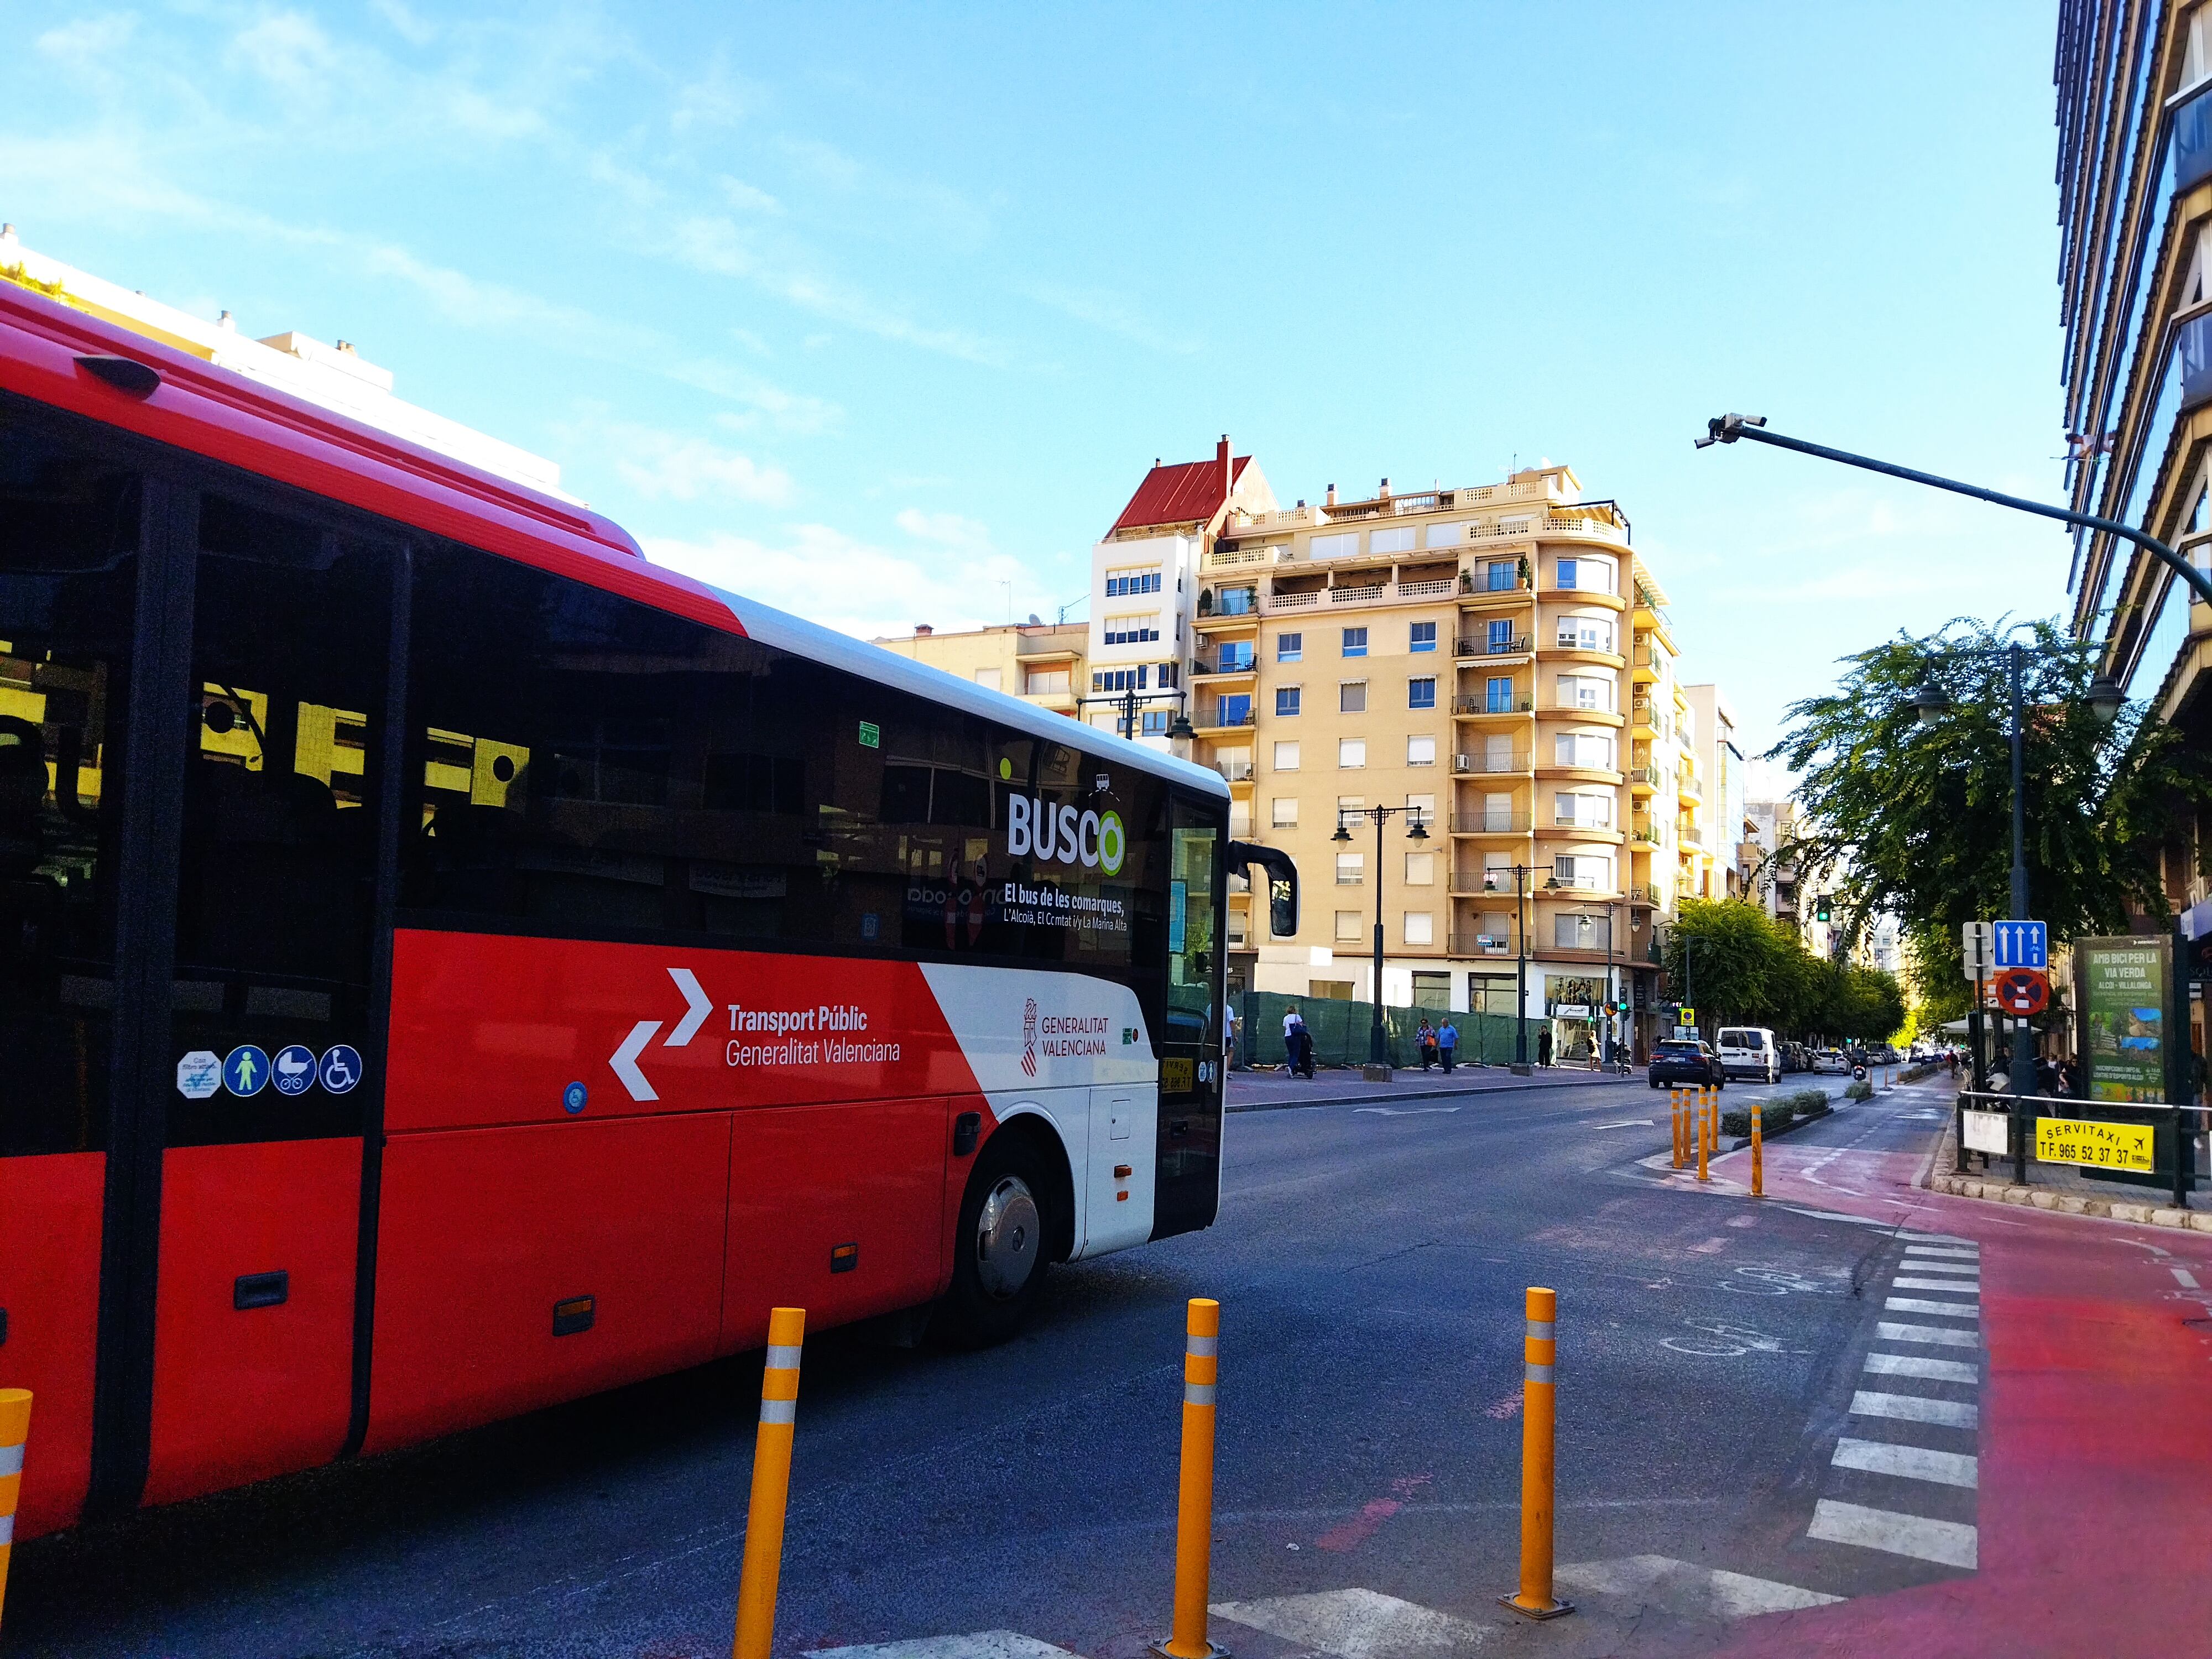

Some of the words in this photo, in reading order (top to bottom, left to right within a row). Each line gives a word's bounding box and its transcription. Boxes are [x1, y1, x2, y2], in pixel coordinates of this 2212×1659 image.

[1008, 793, 1124, 874] BUSCO
[1005, 883, 1016, 902] El
[1019, 884, 1038, 905] bus
[1040, 887, 1052, 906] de
[1056, 888, 1070, 908] les
[1072, 895, 1125, 917] comarques,
[1037, 911, 1045, 925] El
[1073, 915, 1082, 931] i/y
[1083, 916, 1091, 928] La
[1092, 917, 1113, 931] Marina
[1115, 919, 1127, 931] Alta
[2093, 953, 2110, 964] AMB
[2111, 953, 2127, 964] BICI
[2129, 953, 2145, 964] PER
[2146, 952, 2157, 963] LA
[2104, 968, 2117, 978] VIA
[2119, 968, 2146, 978] VERDA
[728, 1004, 815, 1037] Transport
[818, 1005, 867, 1031] Públic
[1042, 1017, 1108, 1034] GENERALITAT
[726, 1037, 818, 1067] Generalitat
[823, 1037, 900, 1063] Valenciana
[1042, 1039, 1106, 1057] VALENCIANA
[2047, 1124, 2120, 1145] SERVITAXI
[2059, 1144, 2075, 1159] 965
[2082, 1146, 2093, 1160] 52
[2099, 1147, 2110, 1162] 37
[2117, 1150, 2128, 1164] 37
